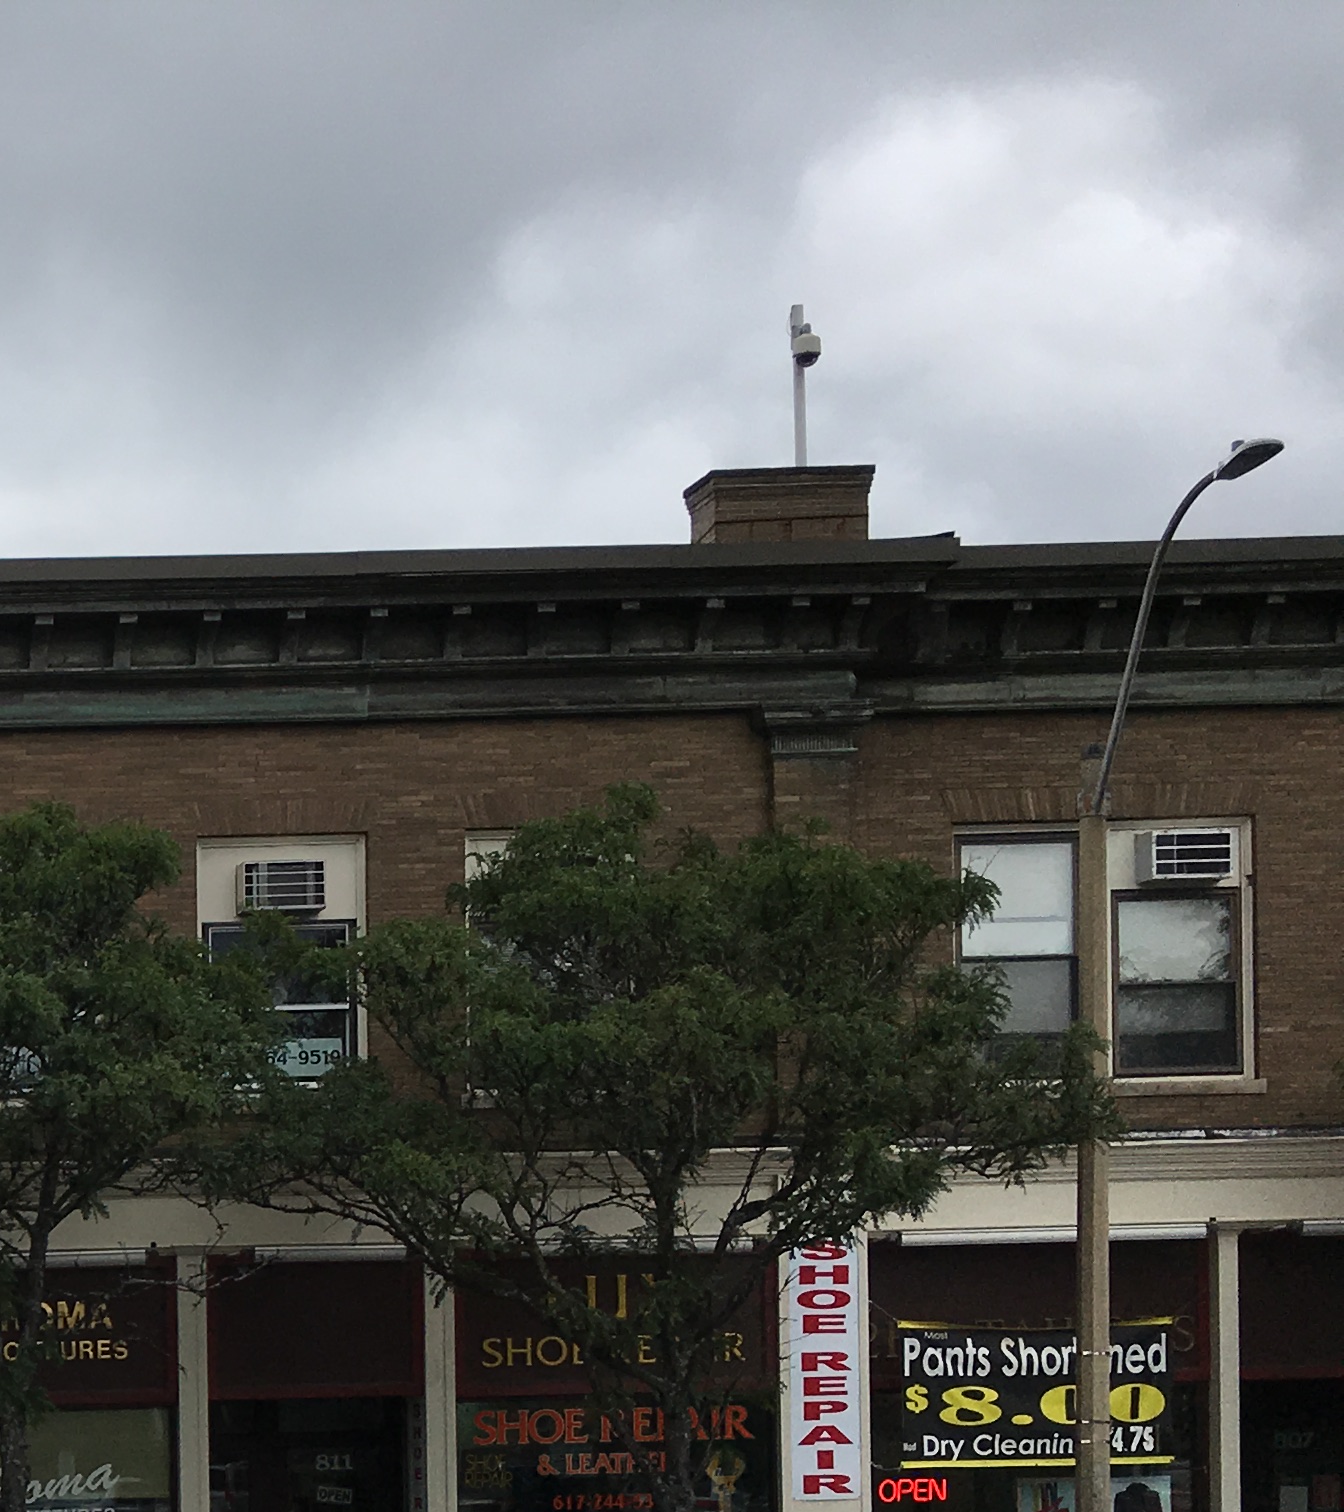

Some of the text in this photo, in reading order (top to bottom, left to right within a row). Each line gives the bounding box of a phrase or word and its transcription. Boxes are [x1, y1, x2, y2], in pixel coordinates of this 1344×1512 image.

[797, 1239, 854, 1494] SHOE REPAIR
[903, 1337, 992, 1377] Pants
[472, 1408, 590, 1445] SHOE
[922, 1434, 966, 1461] Dry
[972, 1431, 1074, 1456] Cleanin
[315, 1454, 353, 1471] 811
[536, 1453, 561, 1476] &
[318, 1488, 352, 1502] OPEN
[878, 1477, 948, 1503] OPEN
